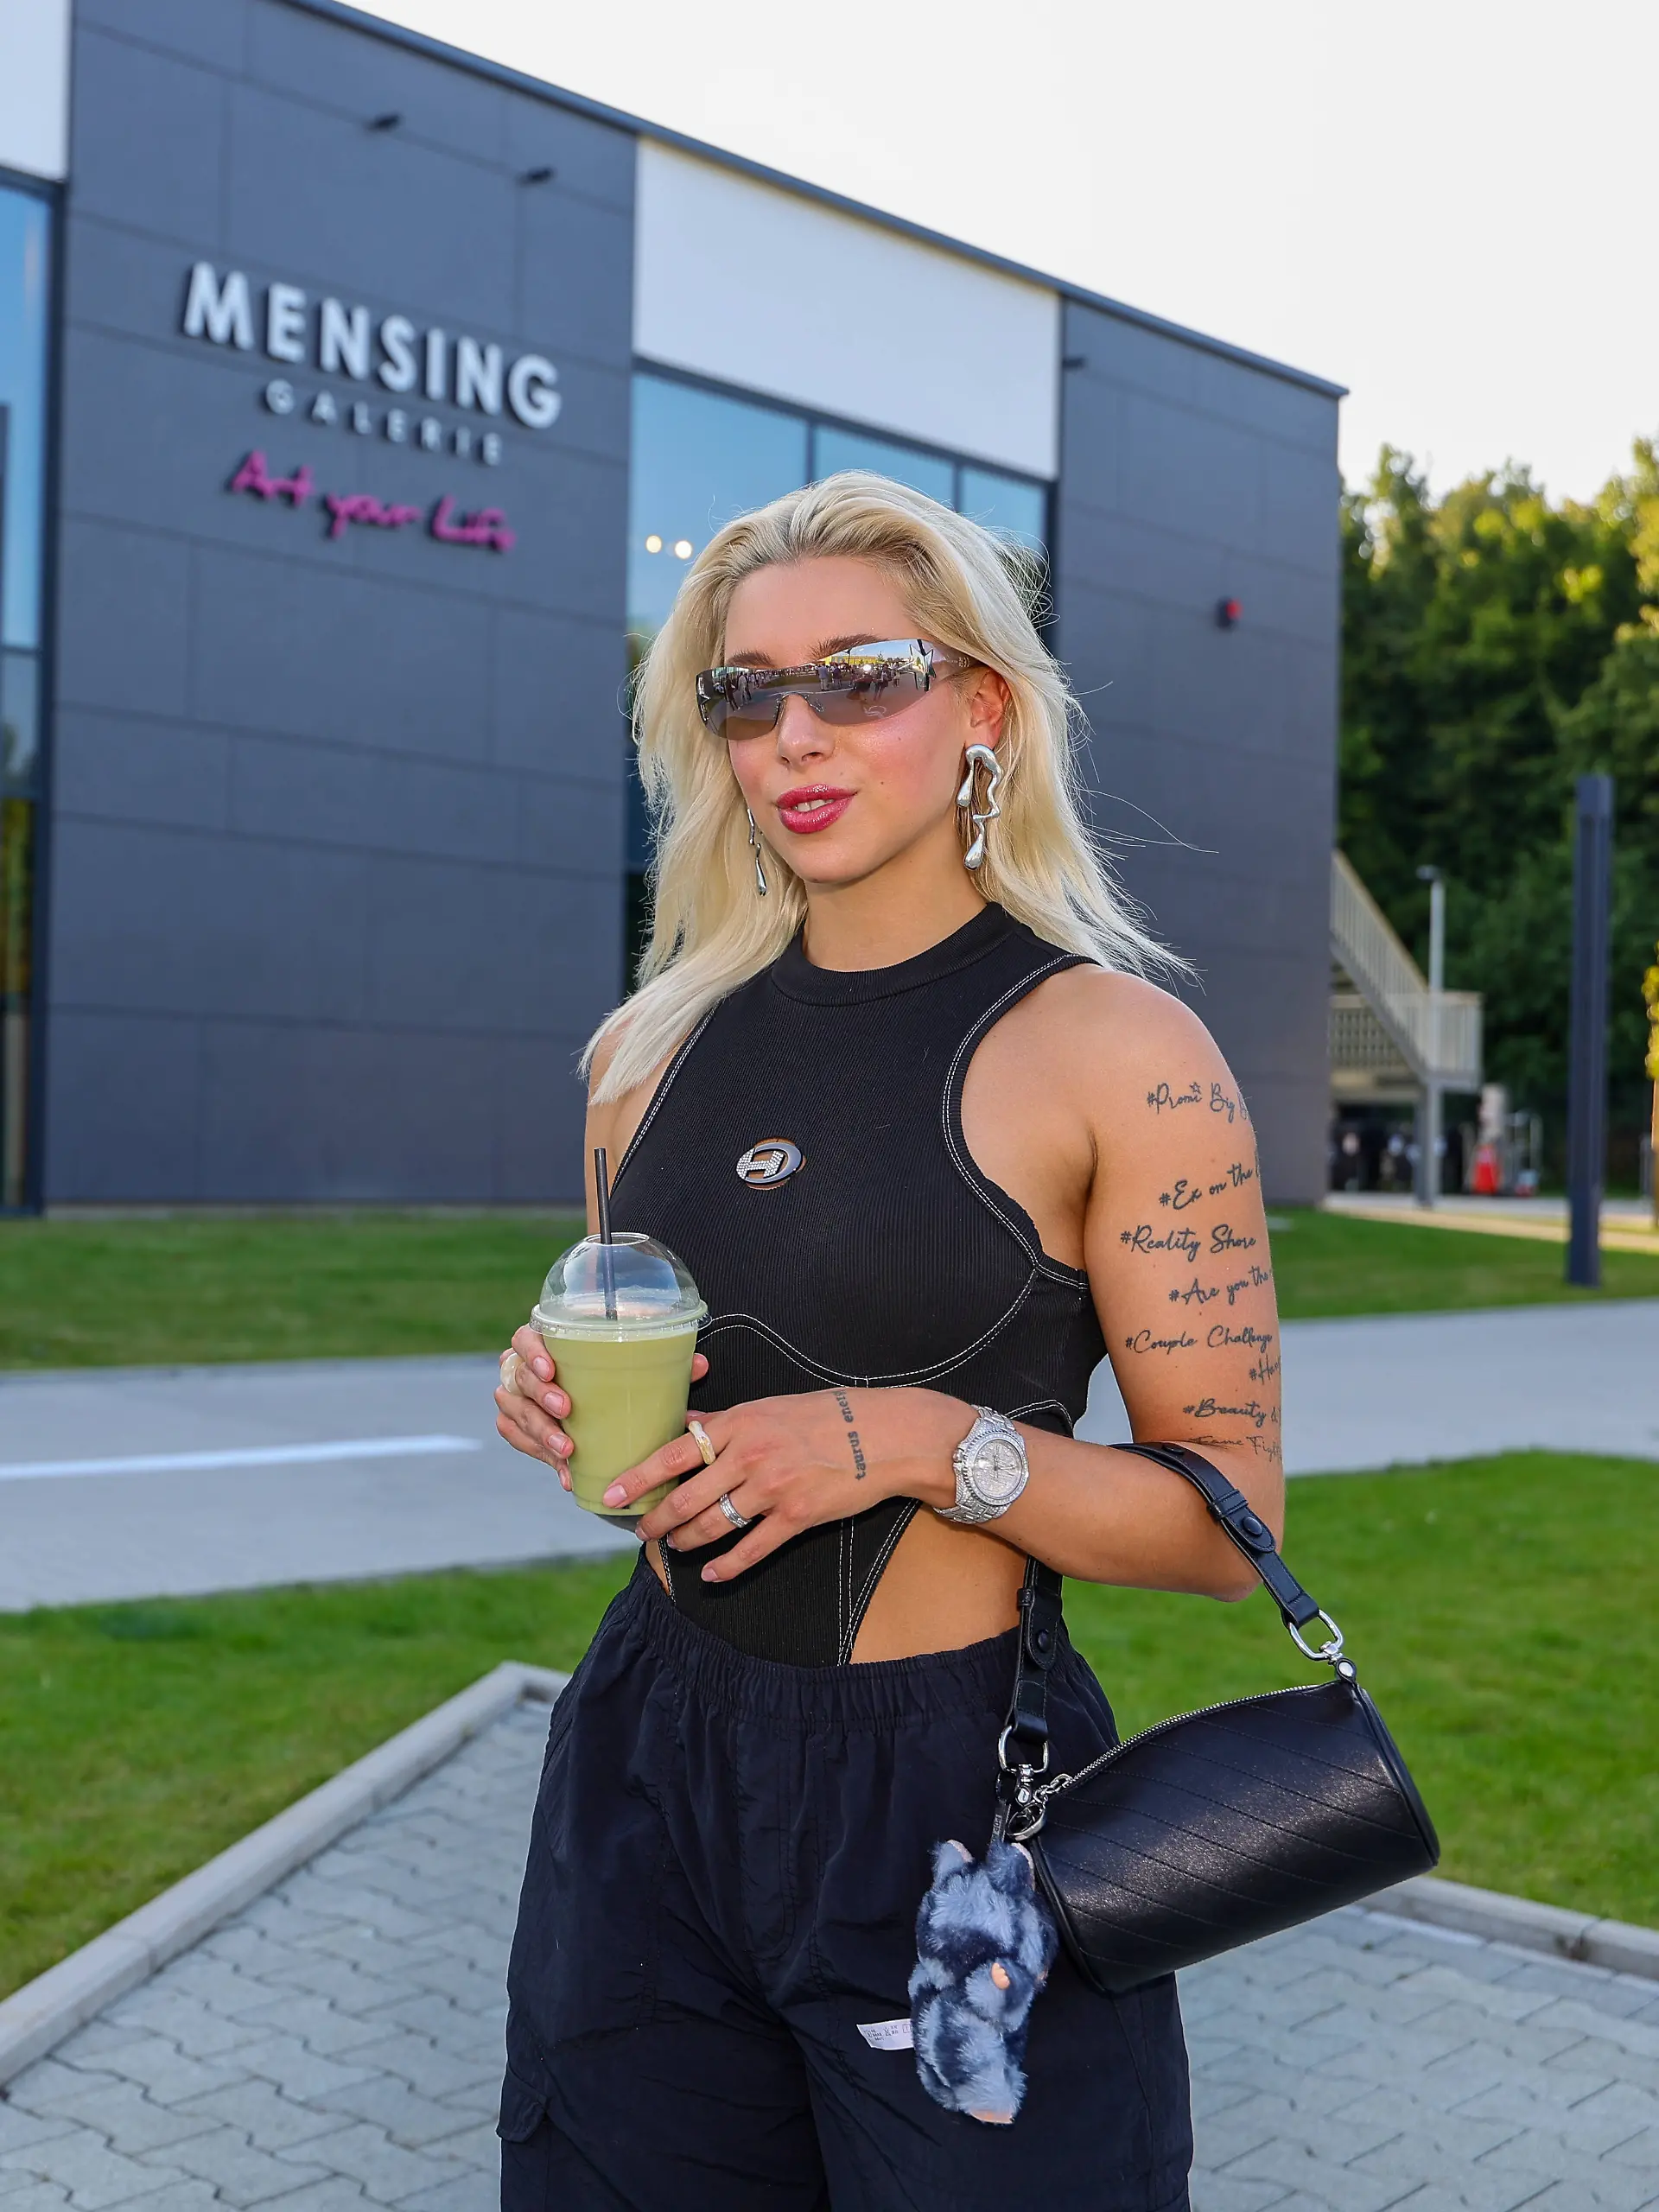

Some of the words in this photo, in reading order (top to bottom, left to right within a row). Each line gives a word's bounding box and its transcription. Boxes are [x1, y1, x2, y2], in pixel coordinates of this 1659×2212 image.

[183, 261, 563, 429] MENSING
[265, 378, 503, 467] GALERIE
[230, 448, 315, 506] Art
[325, 492, 424, 541] your
[1210, 1083, 1236, 1123] Big
[1159, 1179, 1203, 1210] #Ex
[1210, 1181, 1227, 1195] on
[1227, 1163, 1253, 1187] the
[1120, 1224, 1201, 1262] #Reality
[1210, 1224, 1256, 1254] Shore
[1169, 1278, 1219, 1305] #Are
[1227, 1279, 1249, 1306] you
[1248, 1266, 1268, 1287] the
[1125, 1329, 1198, 1355] #Couple
[1182, 1398, 1267, 1428] #Beauty
[848, 1430, 867, 1481] taurus
